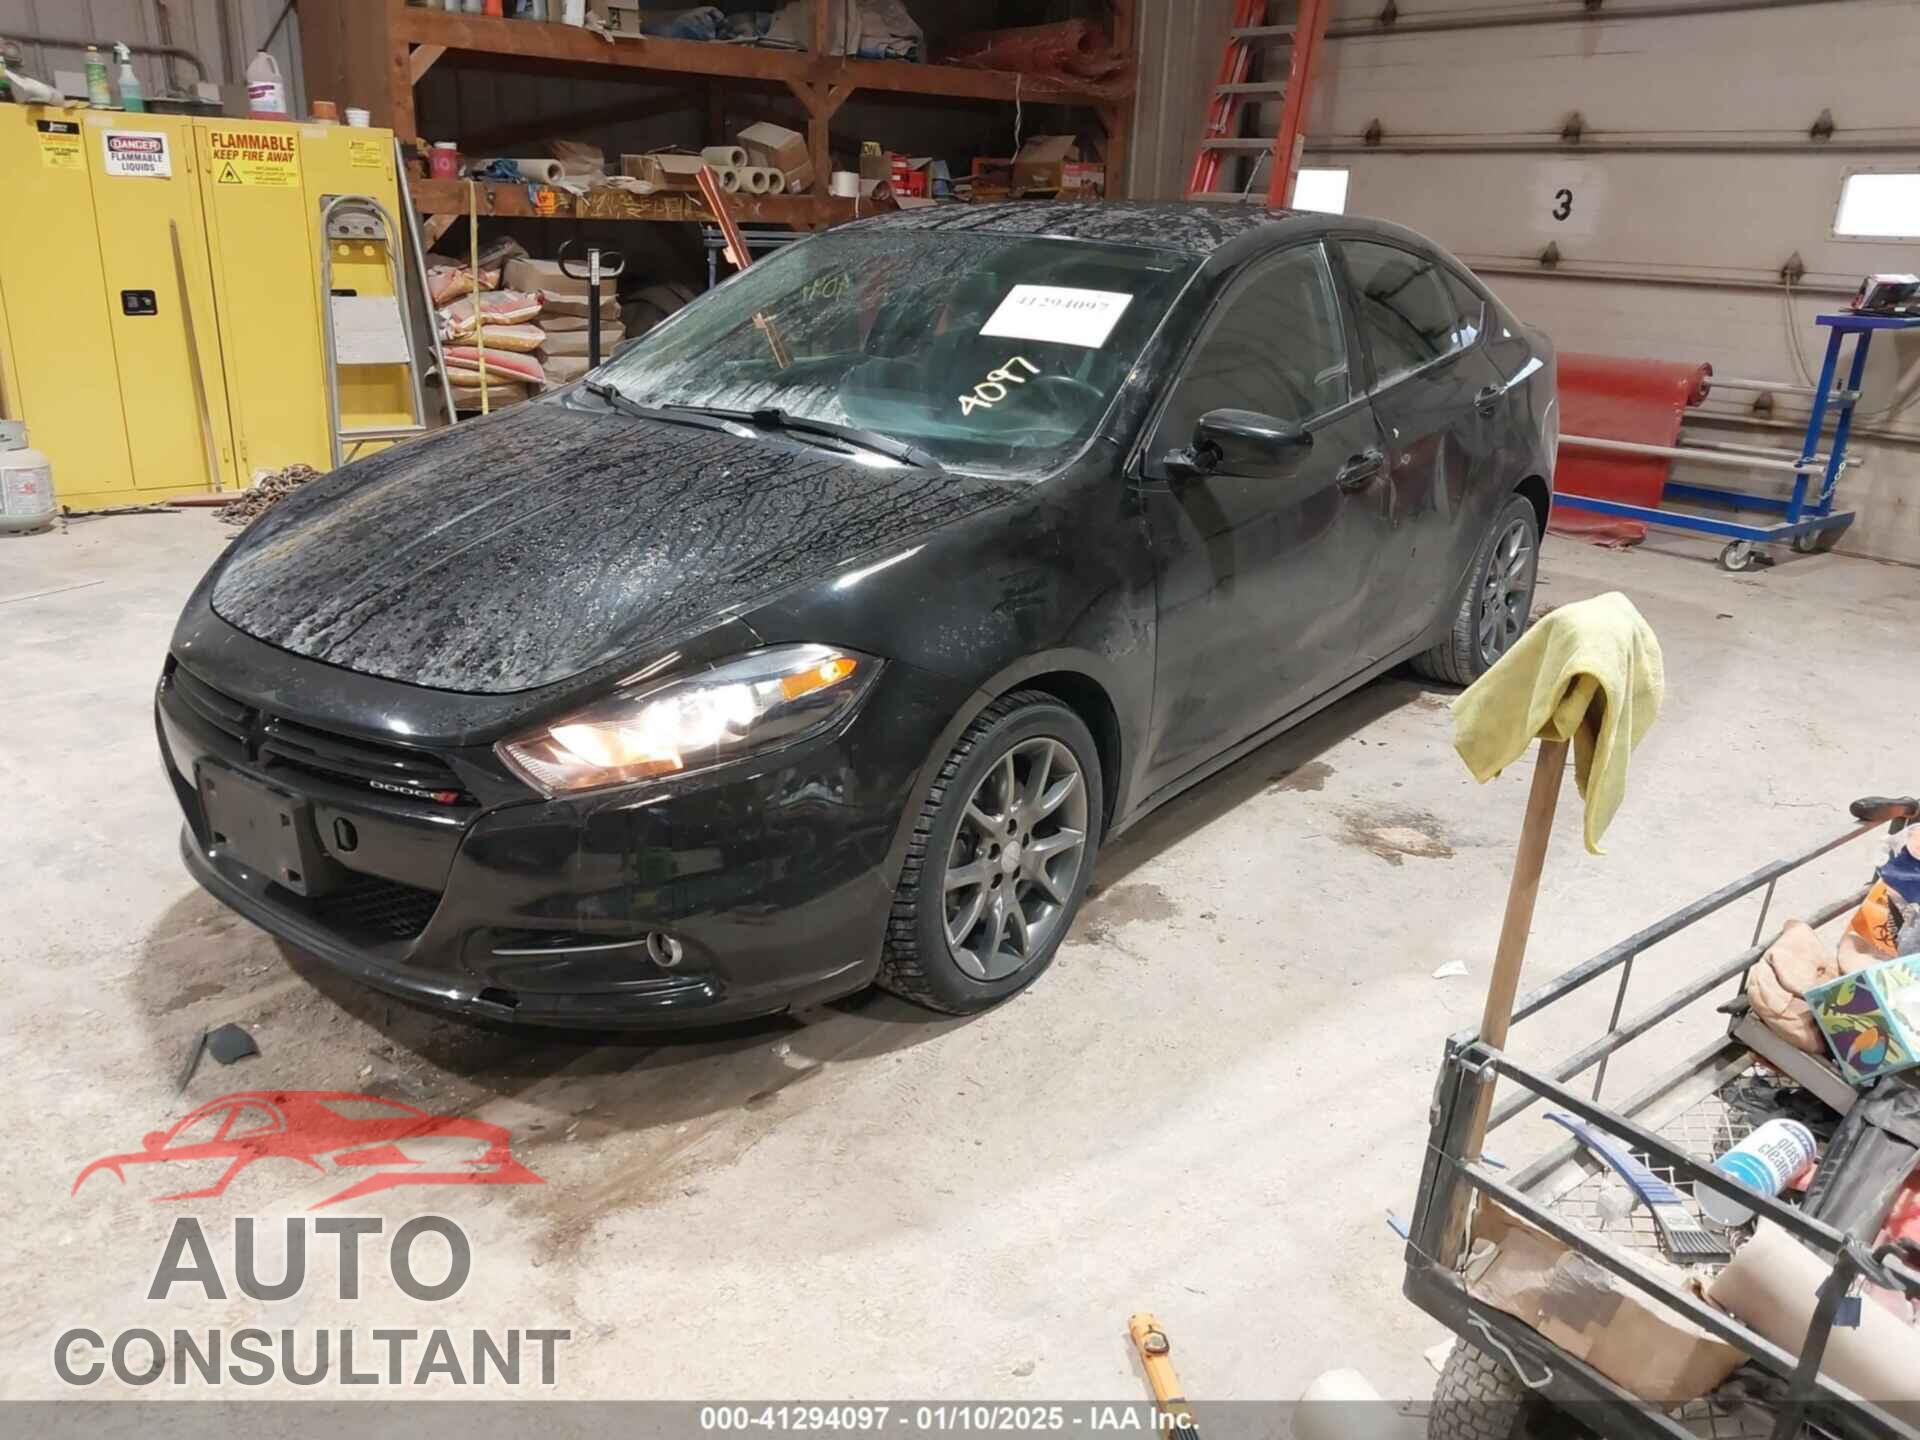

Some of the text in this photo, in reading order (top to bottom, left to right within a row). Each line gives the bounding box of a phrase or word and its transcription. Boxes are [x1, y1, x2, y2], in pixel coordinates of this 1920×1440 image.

[111, 138, 161, 152] DANGER
[211, 132, 294, 151] FLAMMABLE
[111, 152, 163, 162] FLAMMABLE
[213, 149, 294, 163] KEEP FIRE AWAY
[121, 163, 155, 172] LIQUIDS
[1552, 189, 1573, 221] 3
[958, 356, 1041, 416] 4097
